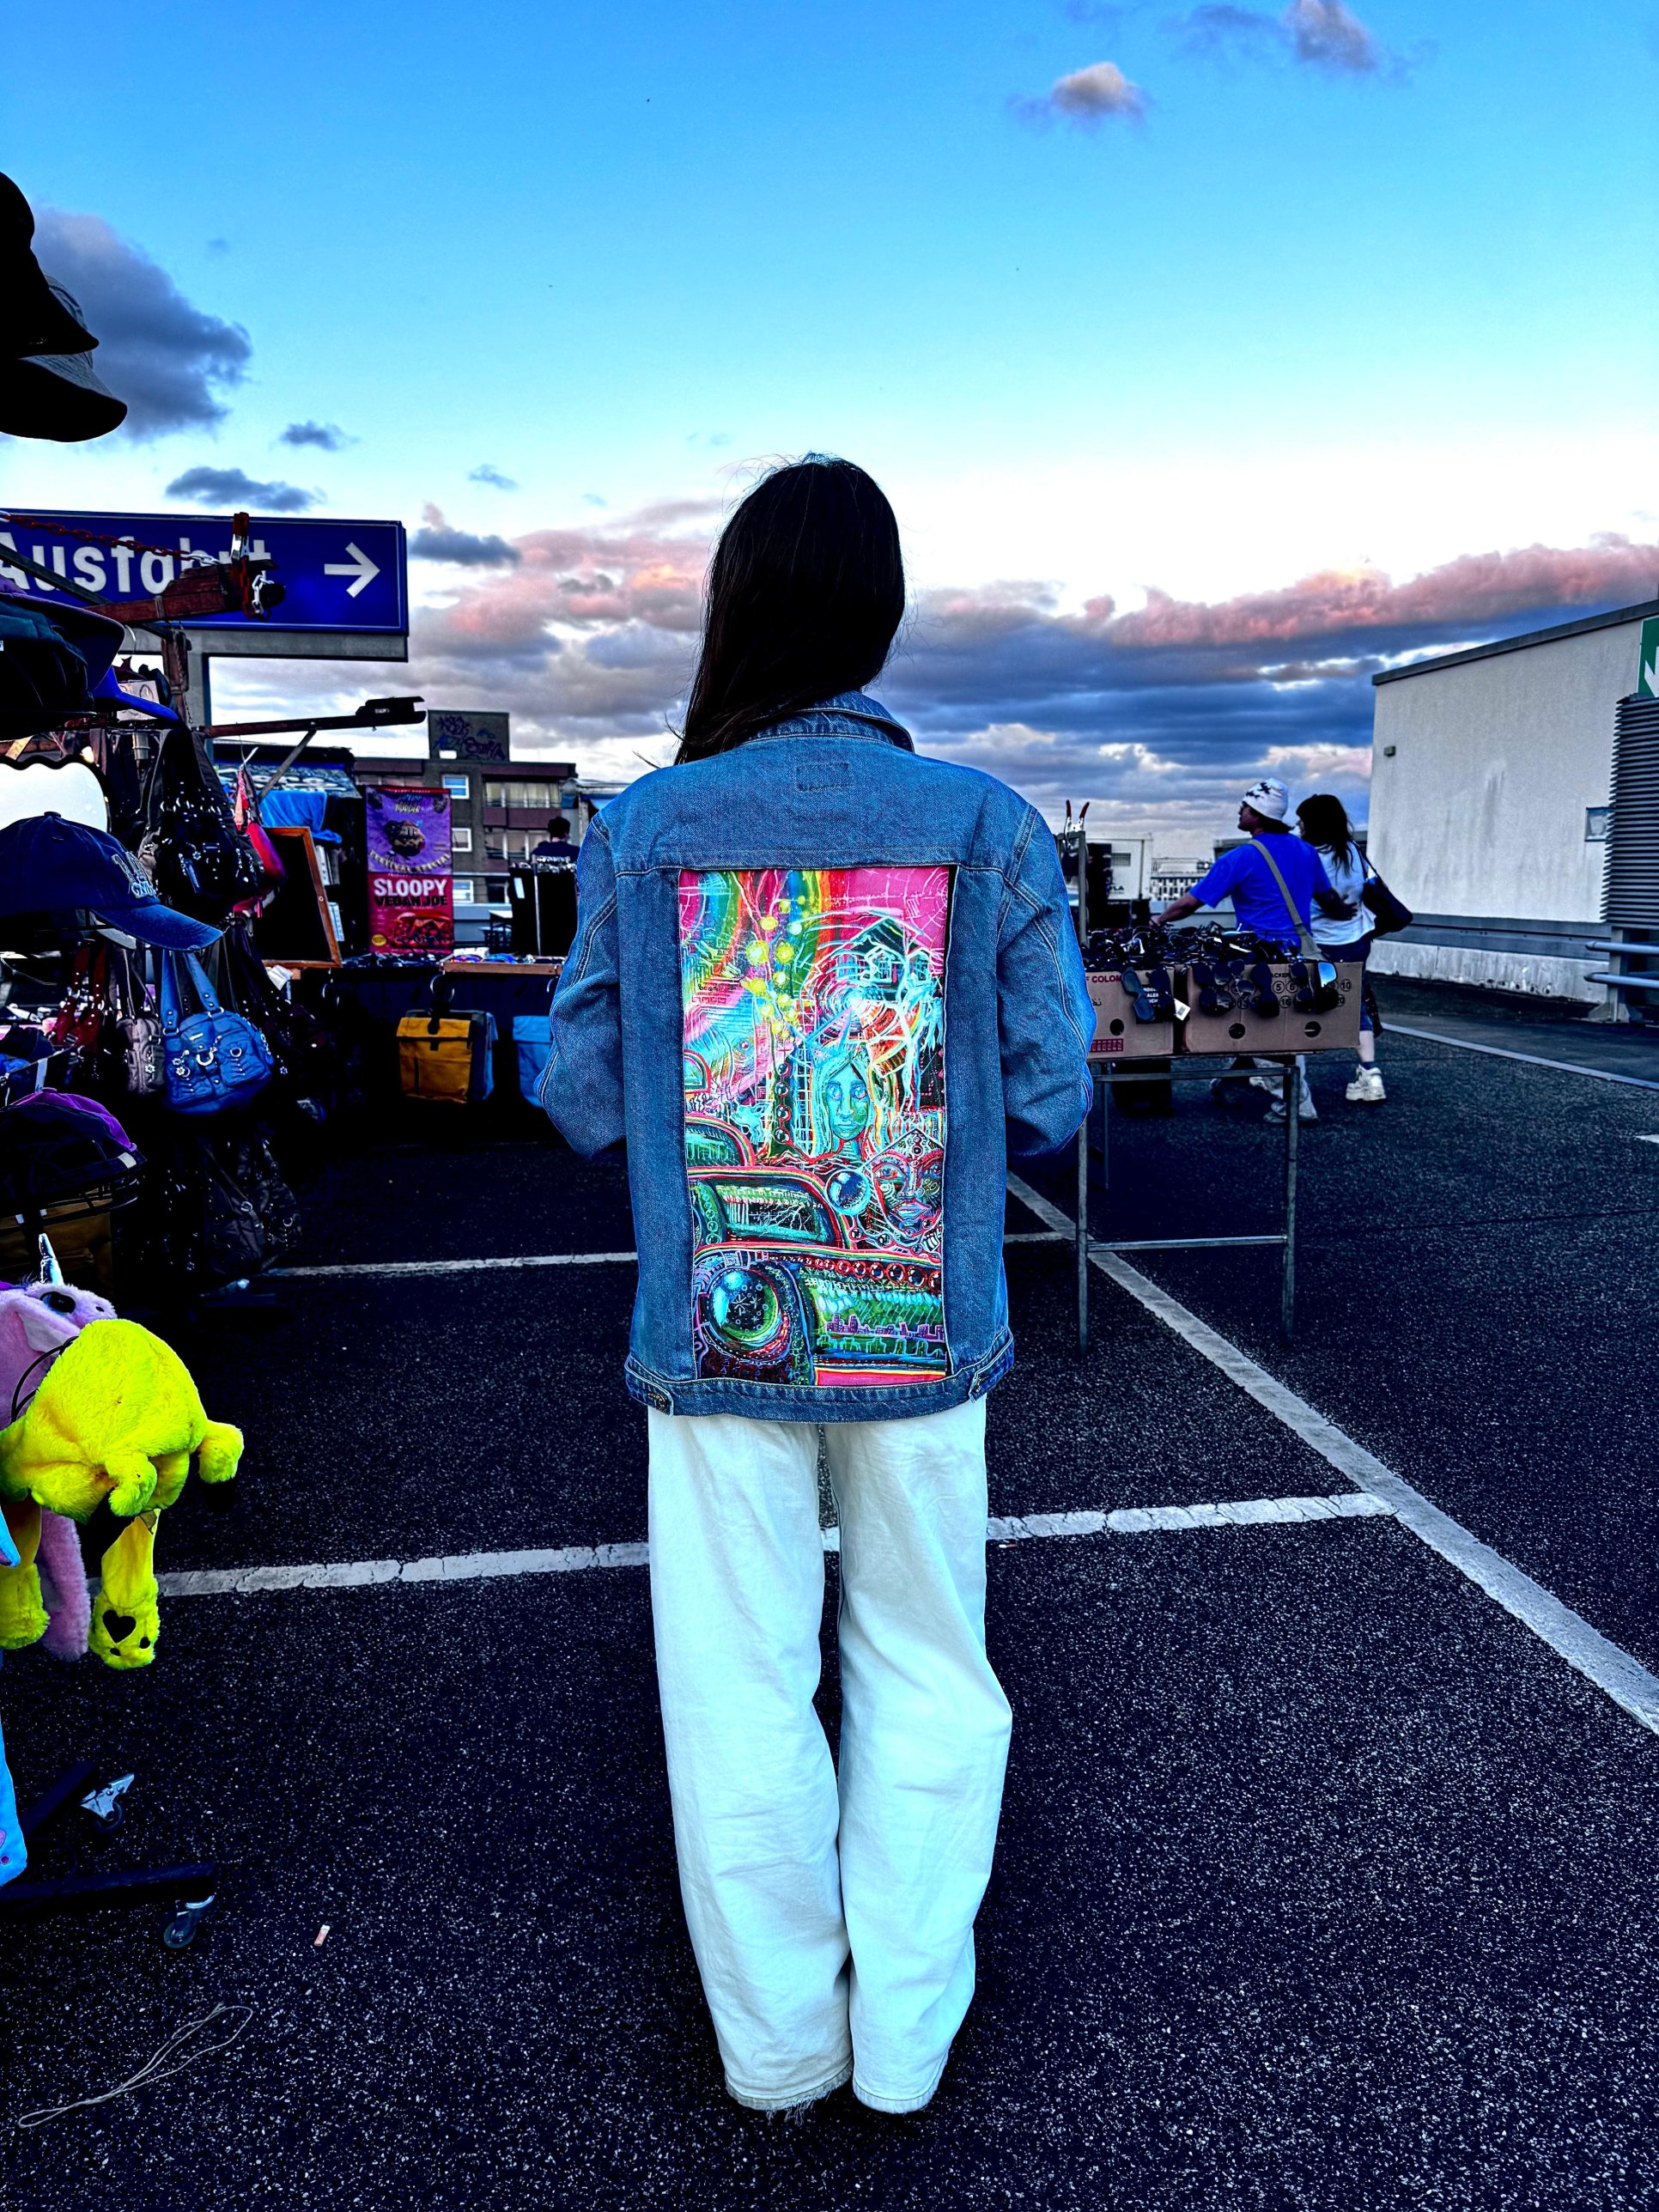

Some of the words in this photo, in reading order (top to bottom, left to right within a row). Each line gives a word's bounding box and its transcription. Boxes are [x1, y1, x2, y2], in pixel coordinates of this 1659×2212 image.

[373, 878, 447, 897] SLOOPY
[374, 896, 421, 907] VEGAN
[423, 896, 447, 906] JOE
[1342, 981, 1351, 990] 10
